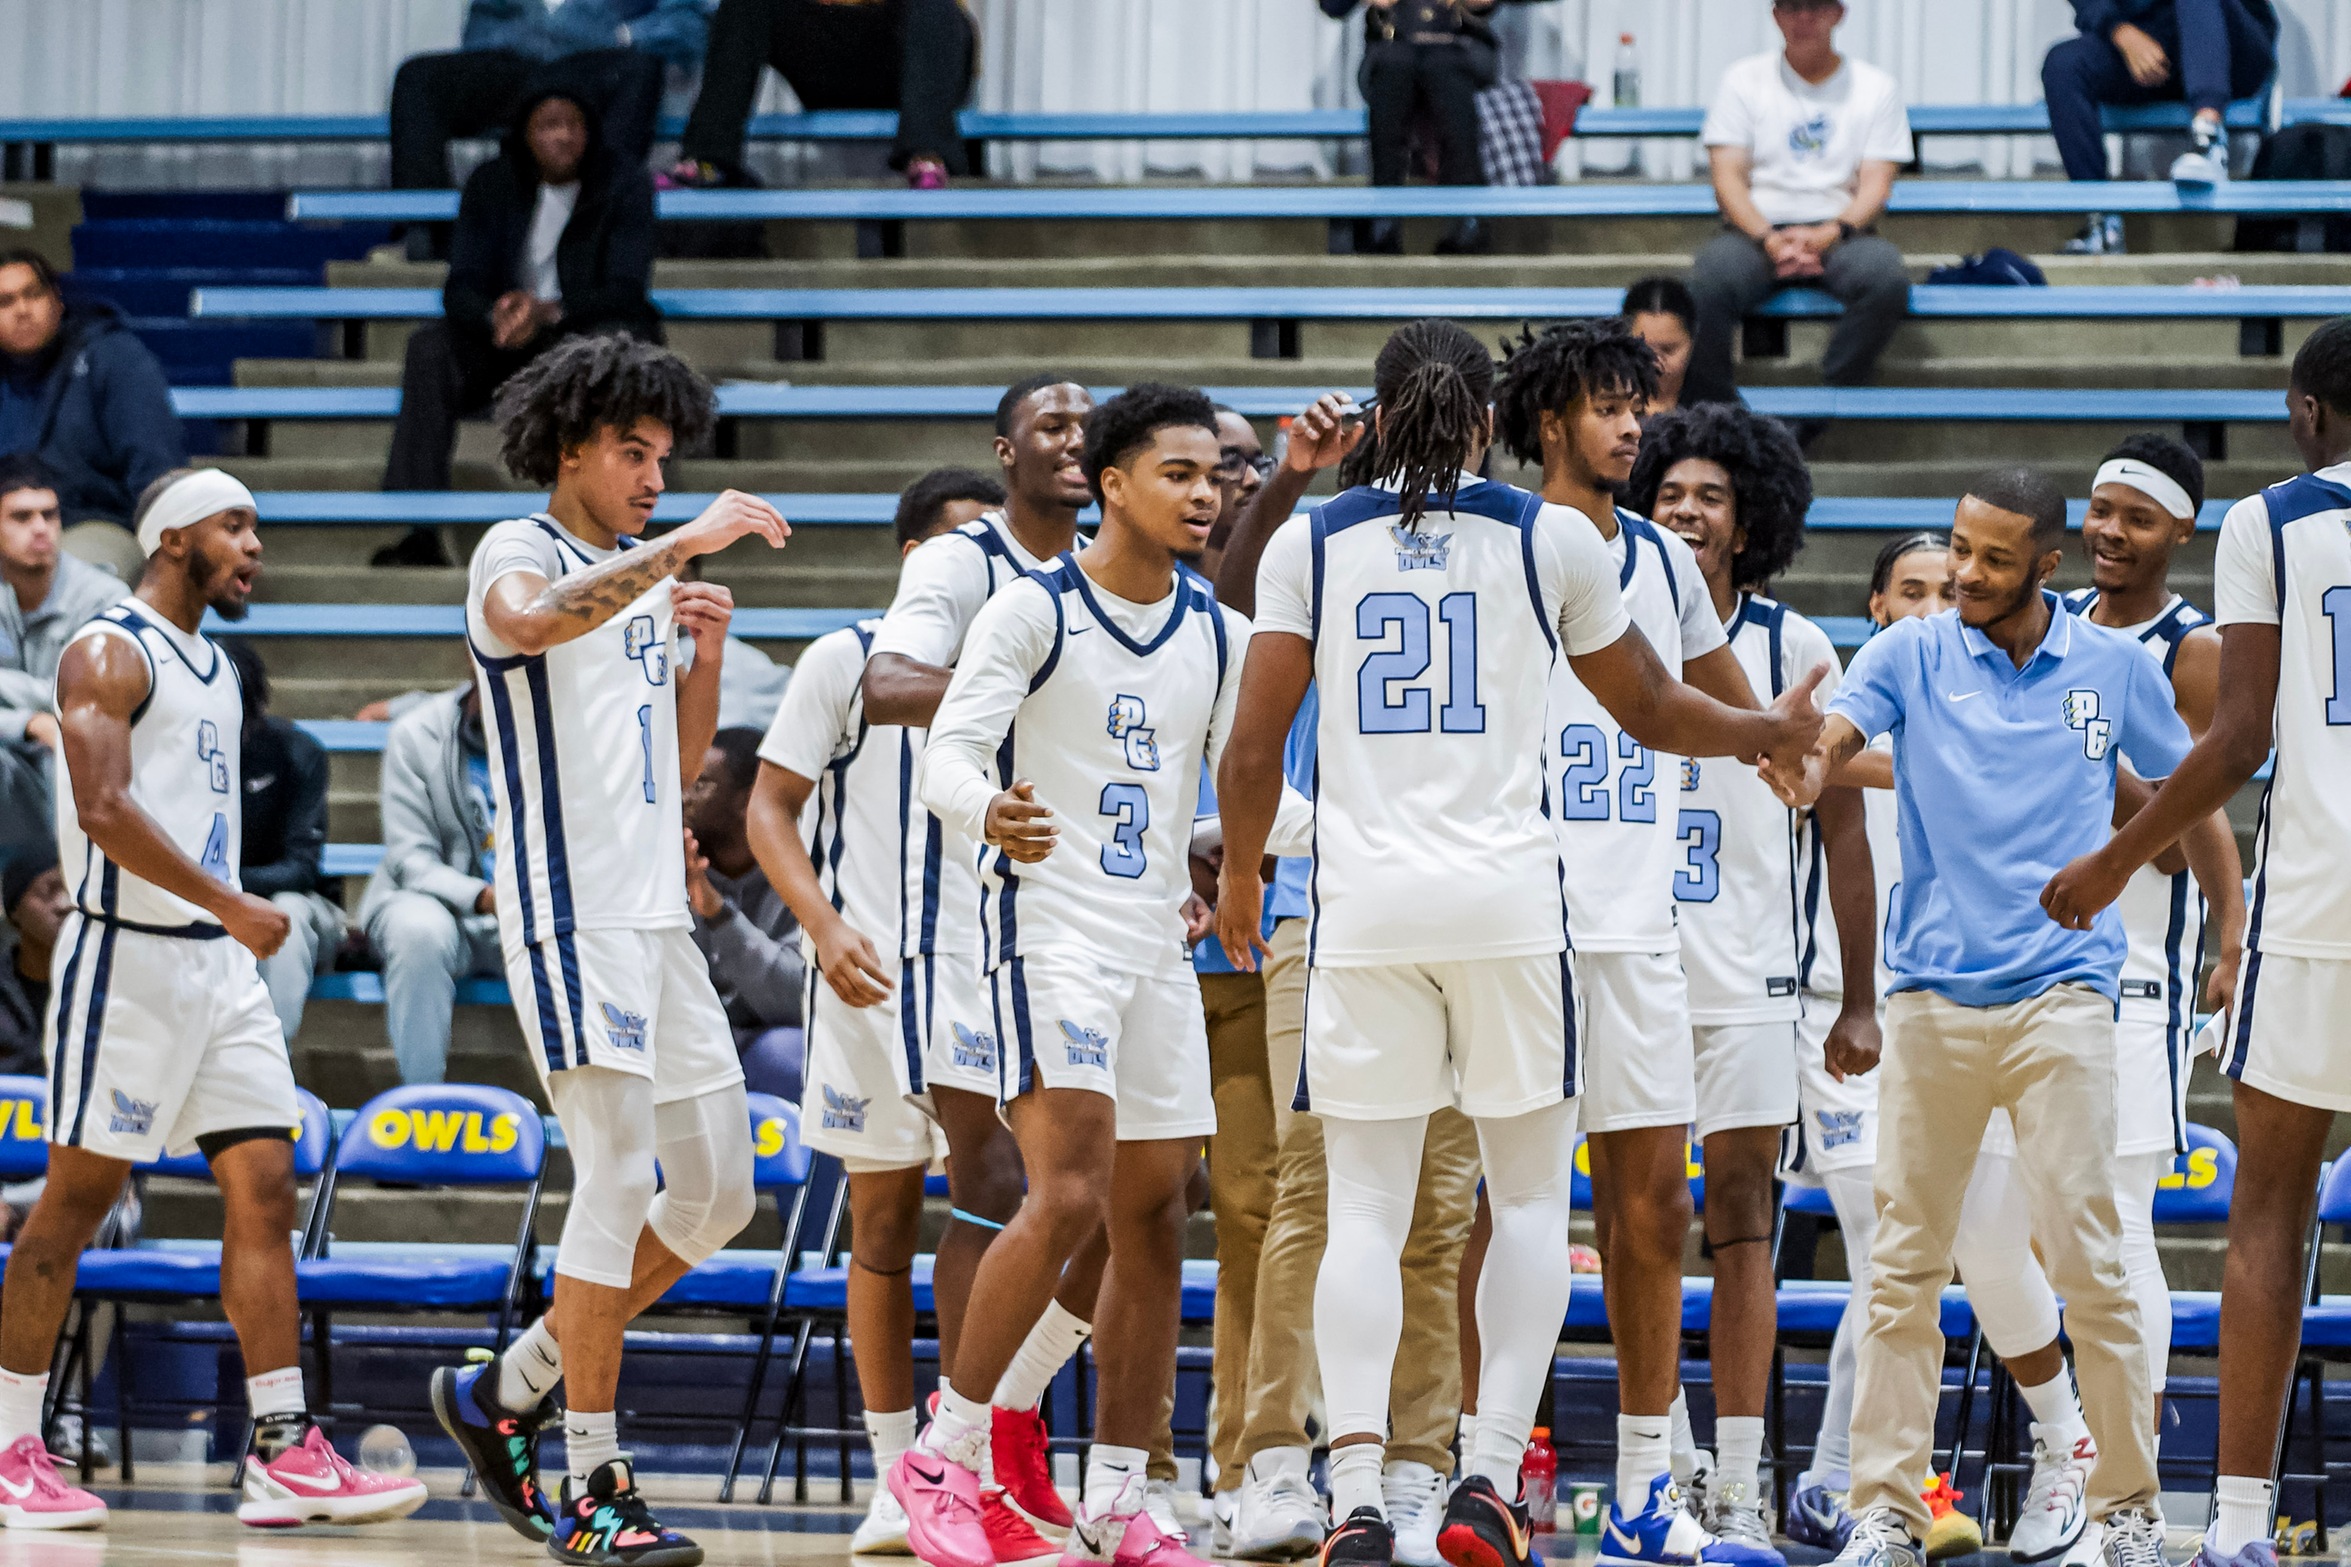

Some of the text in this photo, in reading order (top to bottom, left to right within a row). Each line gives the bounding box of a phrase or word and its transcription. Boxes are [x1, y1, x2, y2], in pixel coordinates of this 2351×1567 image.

[1356, 592, 1486, 734] 21
[2062, 689, 2111, 762] PG
[1561, 724, 1656, 824] 22
[201, 812, 232, 885] 4
[1099, 782, 1149, 879] 3
[370, 1109, 521, 1154] OWLS
